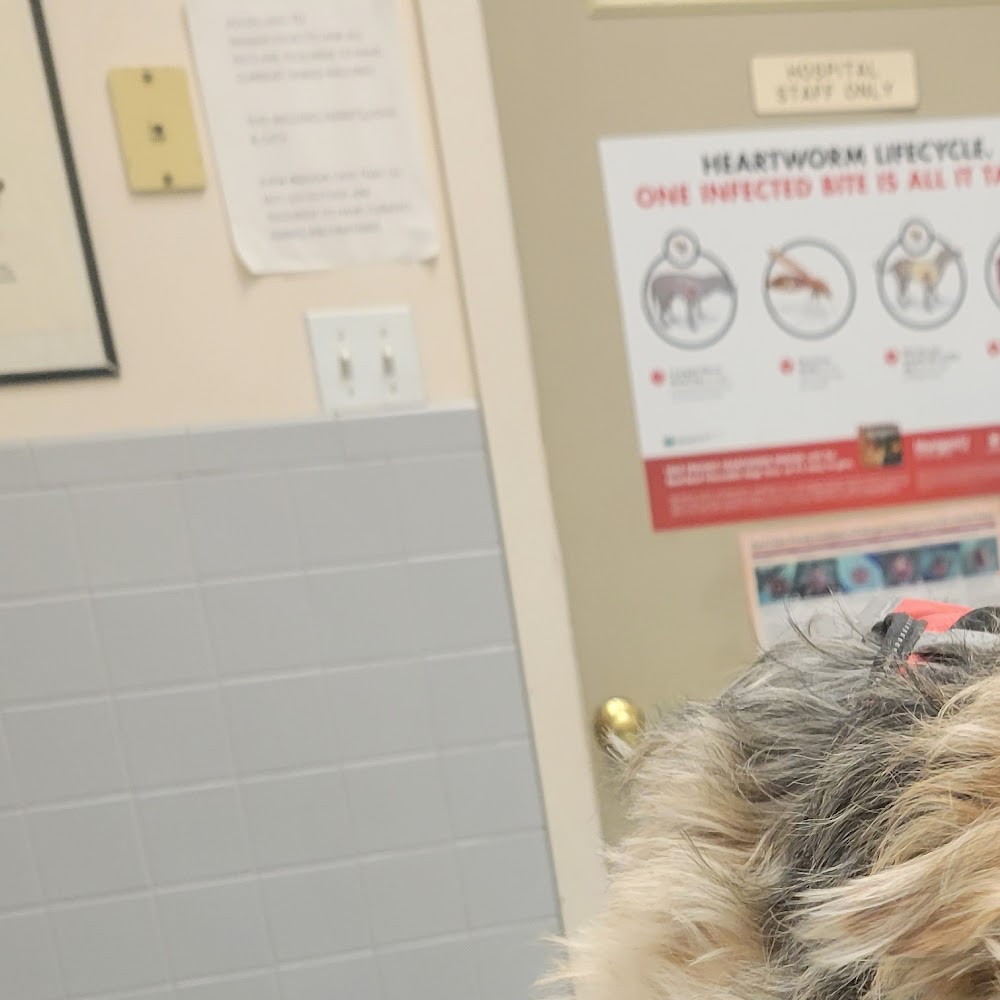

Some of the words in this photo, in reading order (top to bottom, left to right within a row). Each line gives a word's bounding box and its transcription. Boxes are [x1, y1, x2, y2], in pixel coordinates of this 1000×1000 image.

[786, 61, 880, 80] HOSPITAL
[776, 84, 834, 104] STAFF
[845, 81, 895, 101] ONLY
[702, 147, 866, 176] HEARTWORM
[874, 136, 993, 166] LIFECYCLE.
[635, 182, 690, 209] ONE
[700, 174, 814, 206] INFECTED
[820, 168, 868, 198] BITE
[875, 169, 899, 195] IS
[907, 169, 948, 192] ALL
[954, 163, 975, 189] IT
